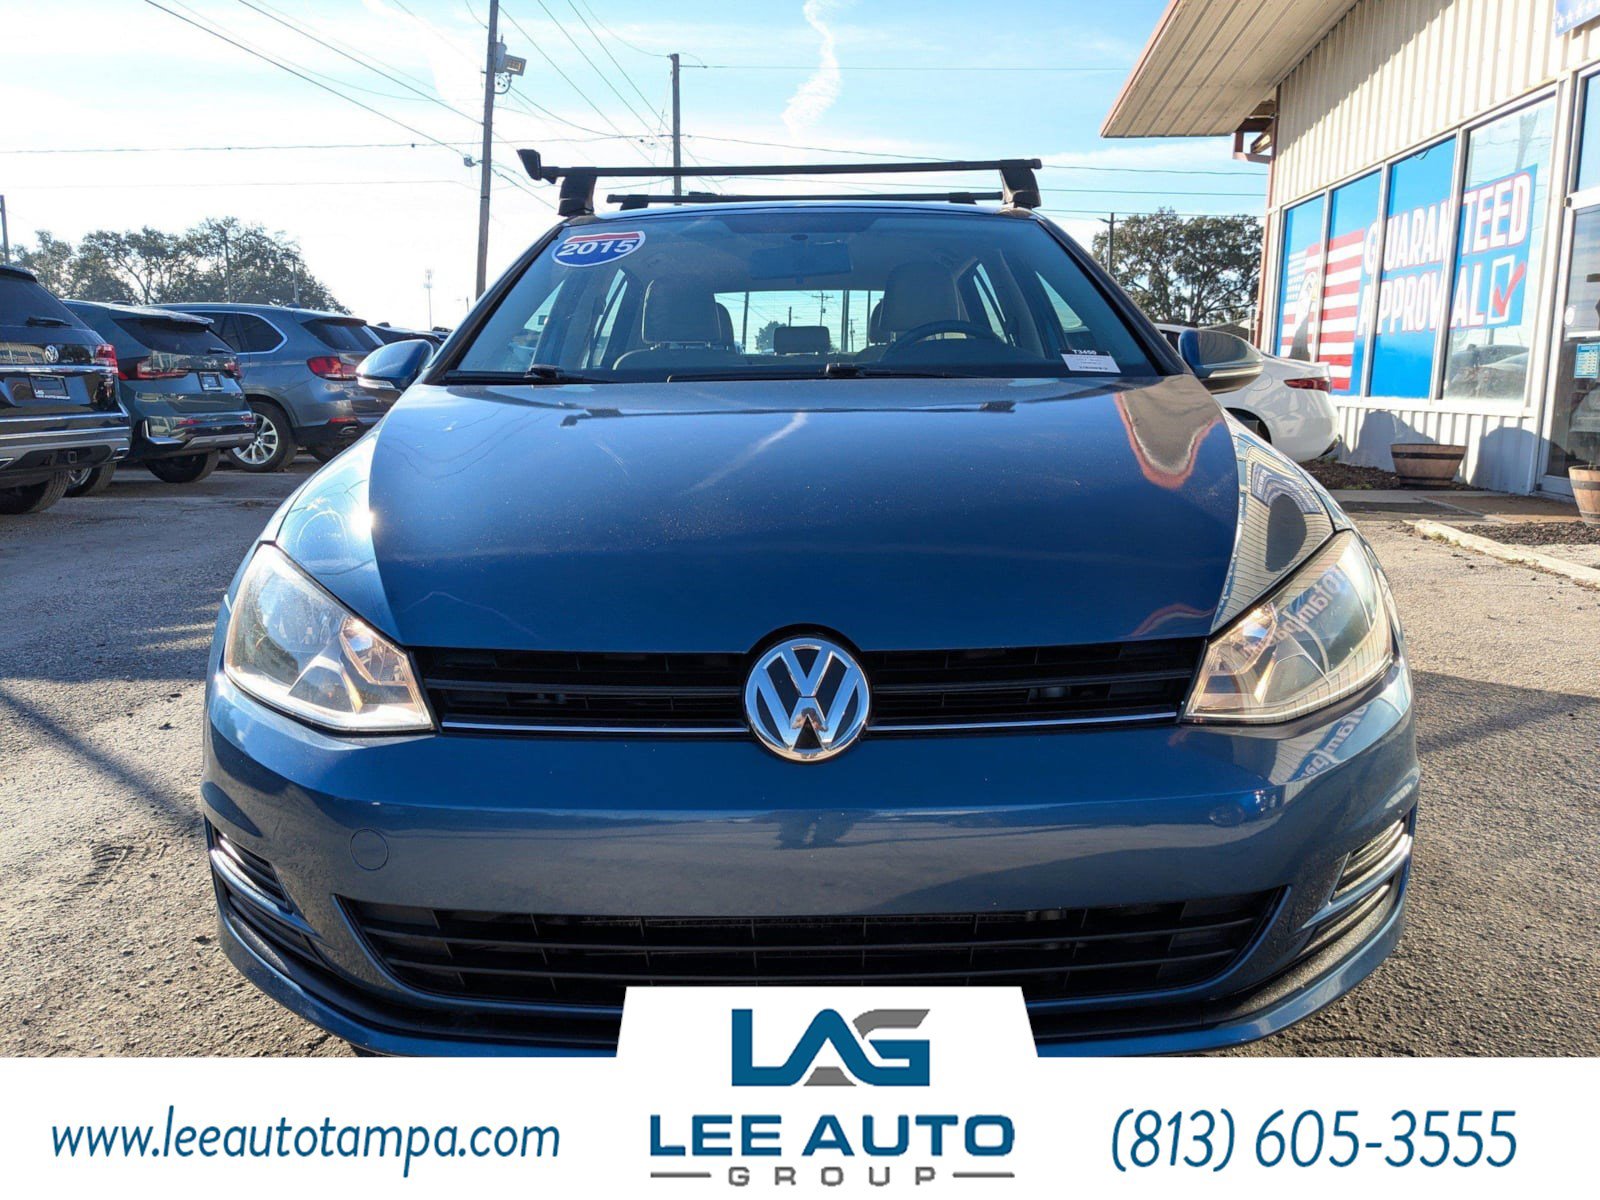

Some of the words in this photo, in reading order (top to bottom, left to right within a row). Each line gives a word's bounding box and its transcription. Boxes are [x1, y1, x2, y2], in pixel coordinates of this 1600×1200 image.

[557, 240, 637, 257] 2015
[1363, 172, 1532, 276] GUARANTEED
[1356, 262, 1485, 337] APPROVAL
